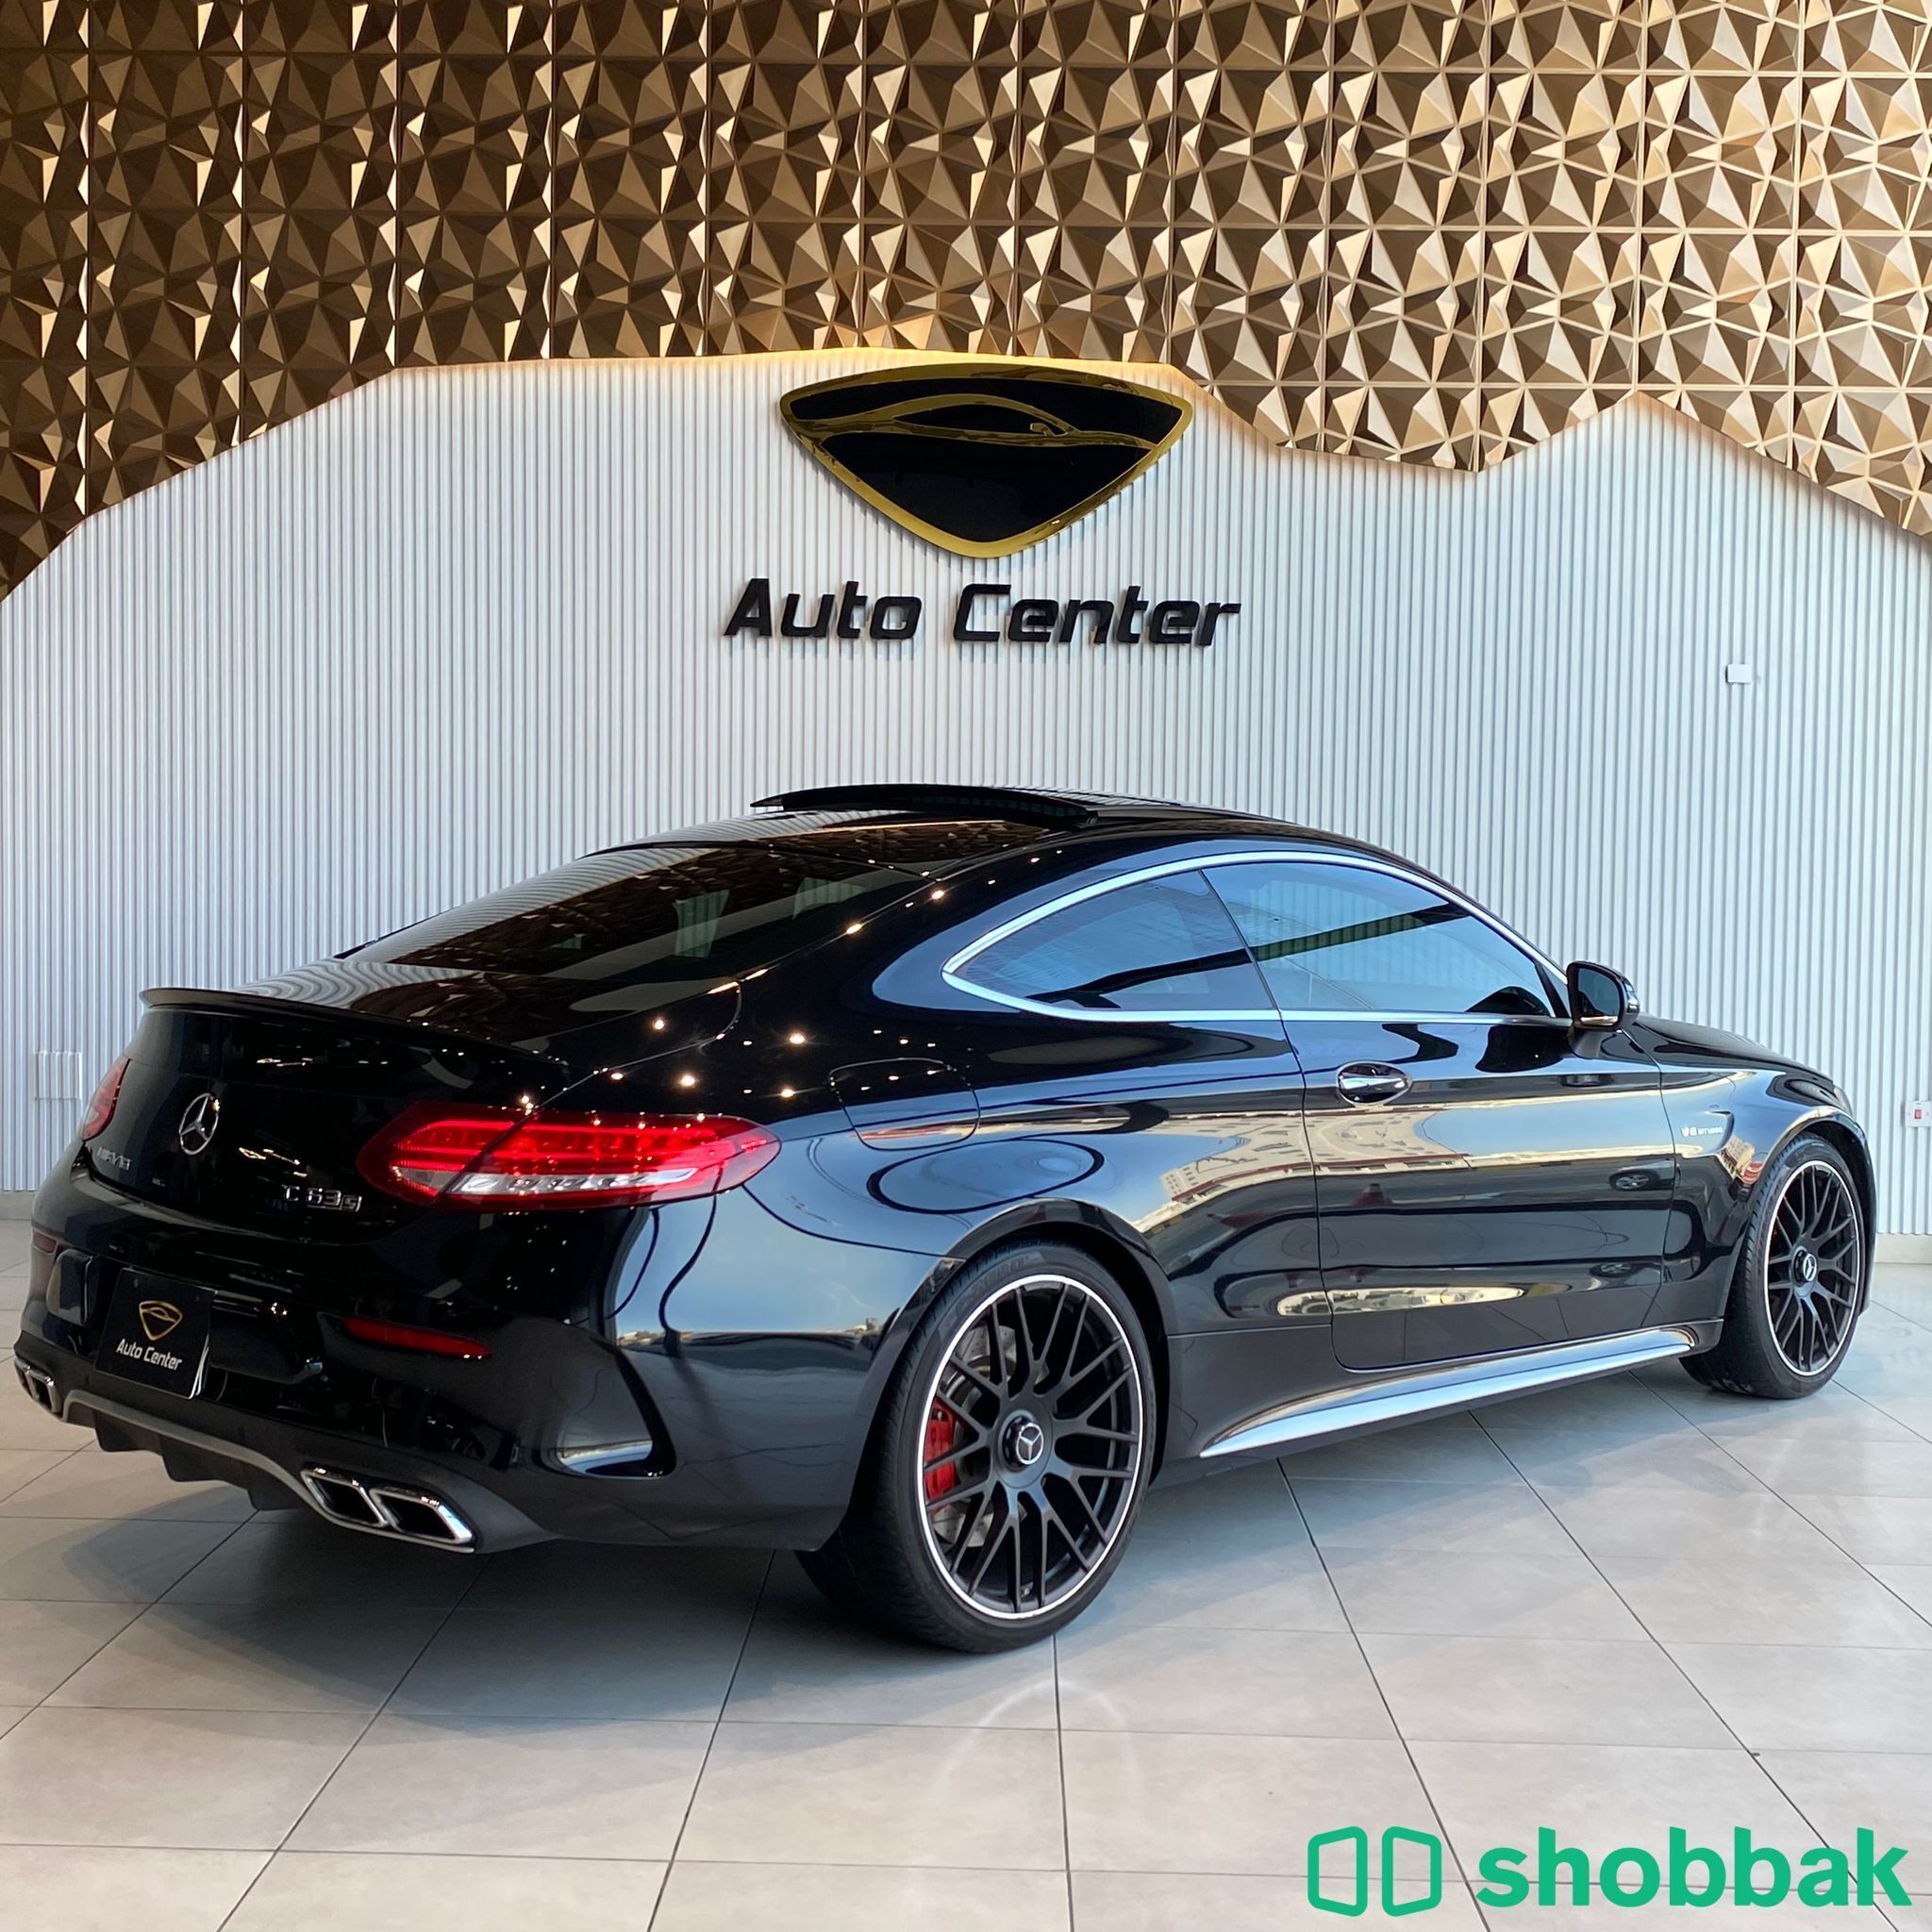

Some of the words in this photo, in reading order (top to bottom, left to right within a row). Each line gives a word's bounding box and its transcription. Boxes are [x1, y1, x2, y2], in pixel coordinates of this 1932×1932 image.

[724, 577, 923, 640] Auto
[952, 583, 1241, 646] Center
[115, 1338, 143, 1359] Auto
[143, 1346, 183, 1371] Center
